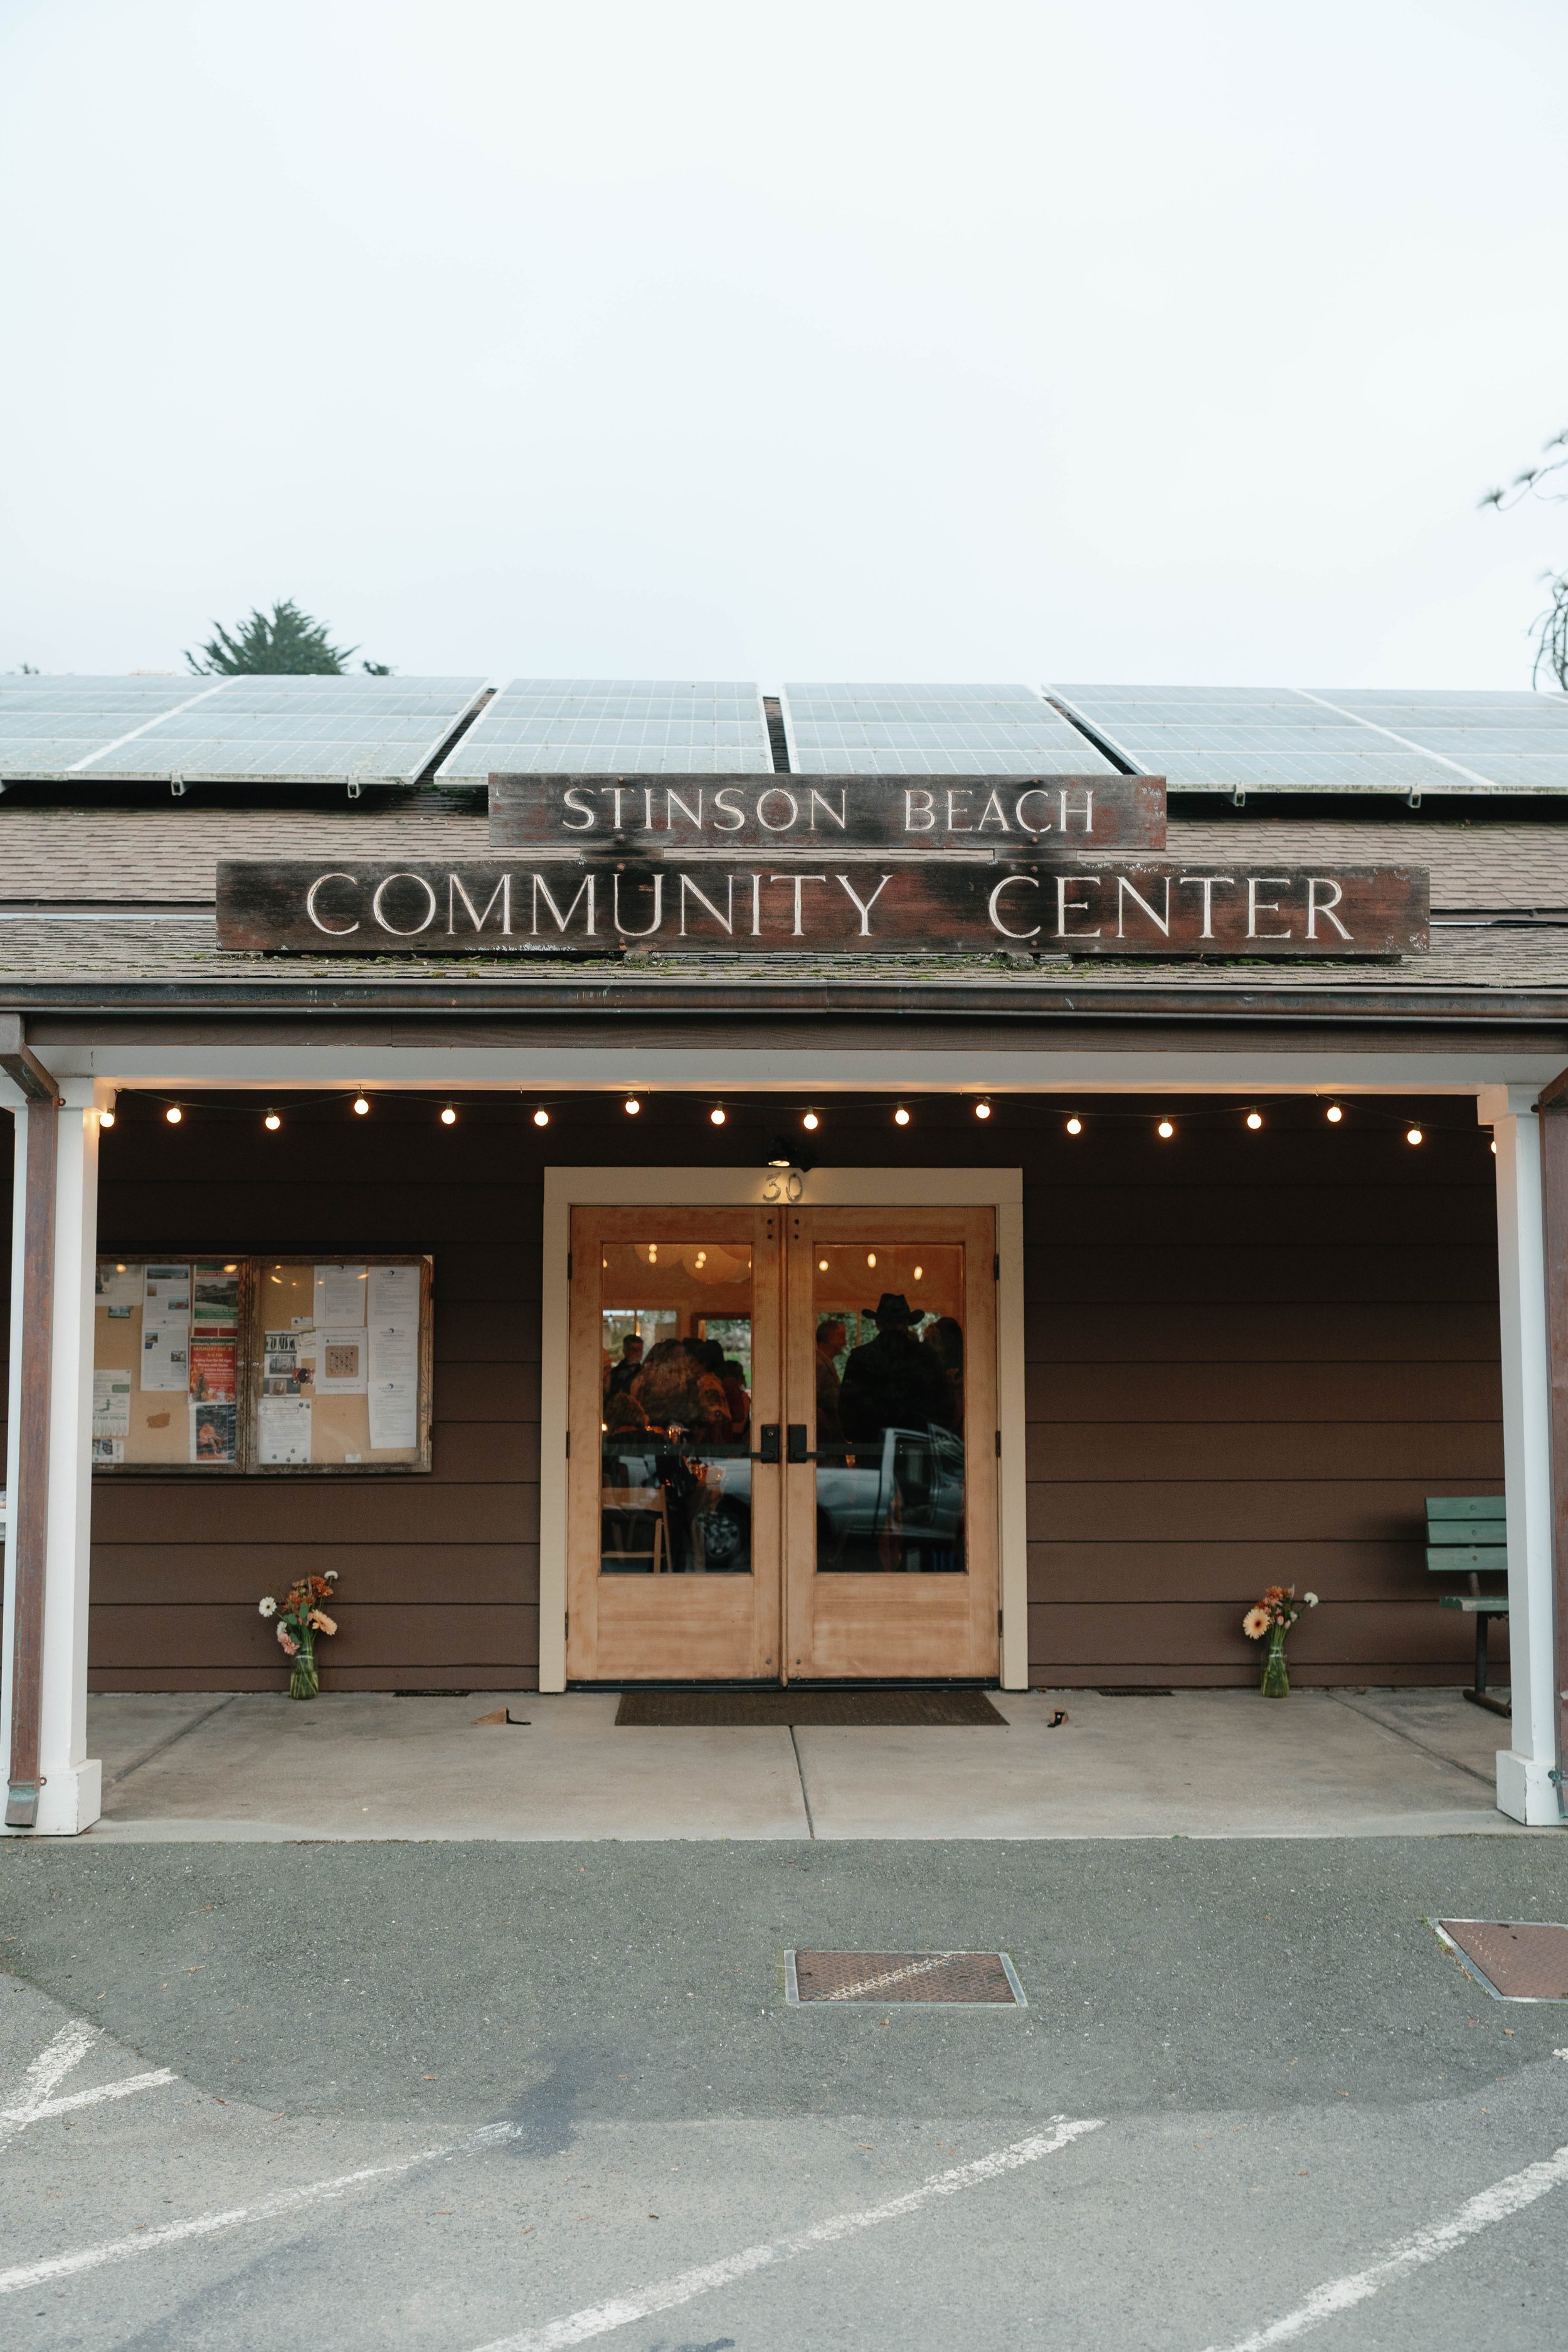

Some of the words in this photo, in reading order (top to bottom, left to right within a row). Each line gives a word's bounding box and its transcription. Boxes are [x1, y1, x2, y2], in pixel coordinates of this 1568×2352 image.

[562, 787, 847, 832] STINSON
[903, 788, 1094, 834] BEACH
[306, 872, 894, 938] COMMUNITY
[988, 874, 1354, 941] CENTER
[763, 1172, 803, 1203] 30
